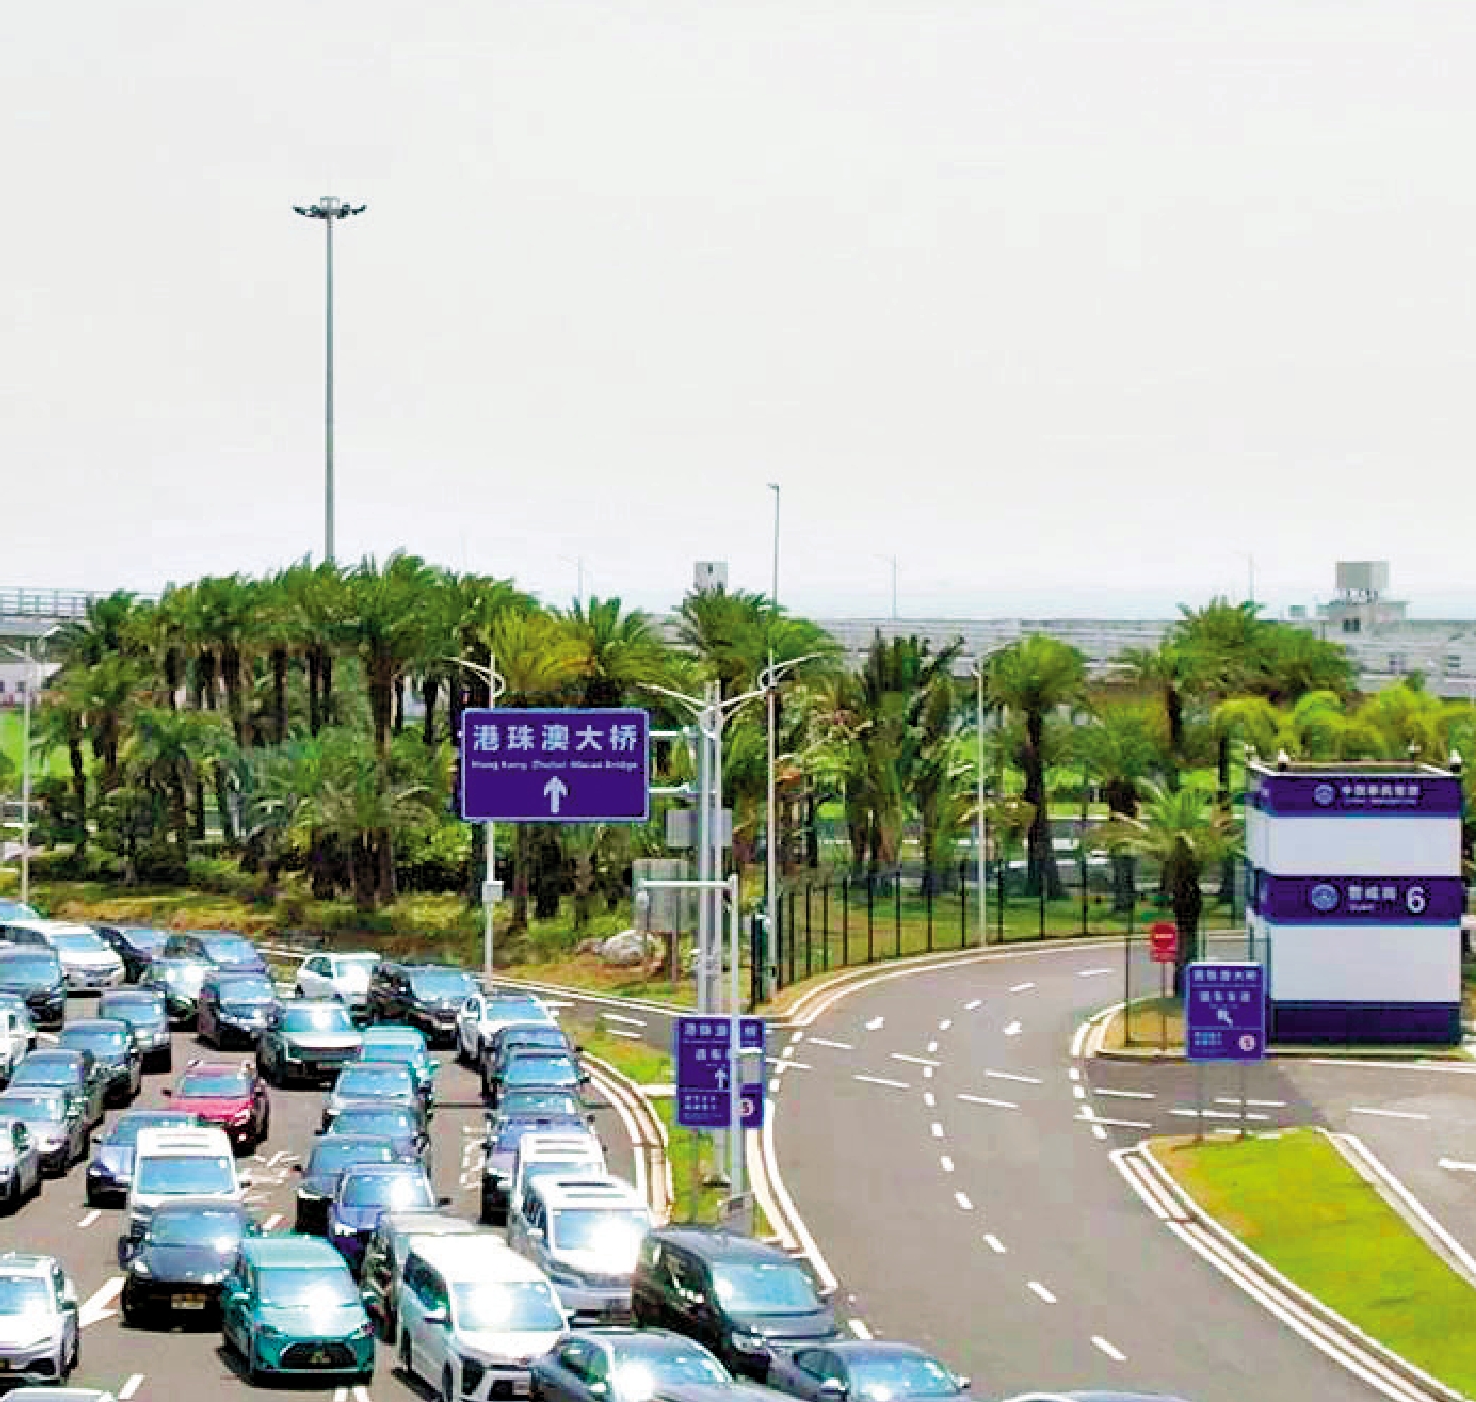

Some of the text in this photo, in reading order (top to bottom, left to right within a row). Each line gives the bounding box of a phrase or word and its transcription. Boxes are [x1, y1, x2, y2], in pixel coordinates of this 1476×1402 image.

[473, 724, 637, 752] 港珠澳大桥
[1407, 886, 1426, 914] 6
